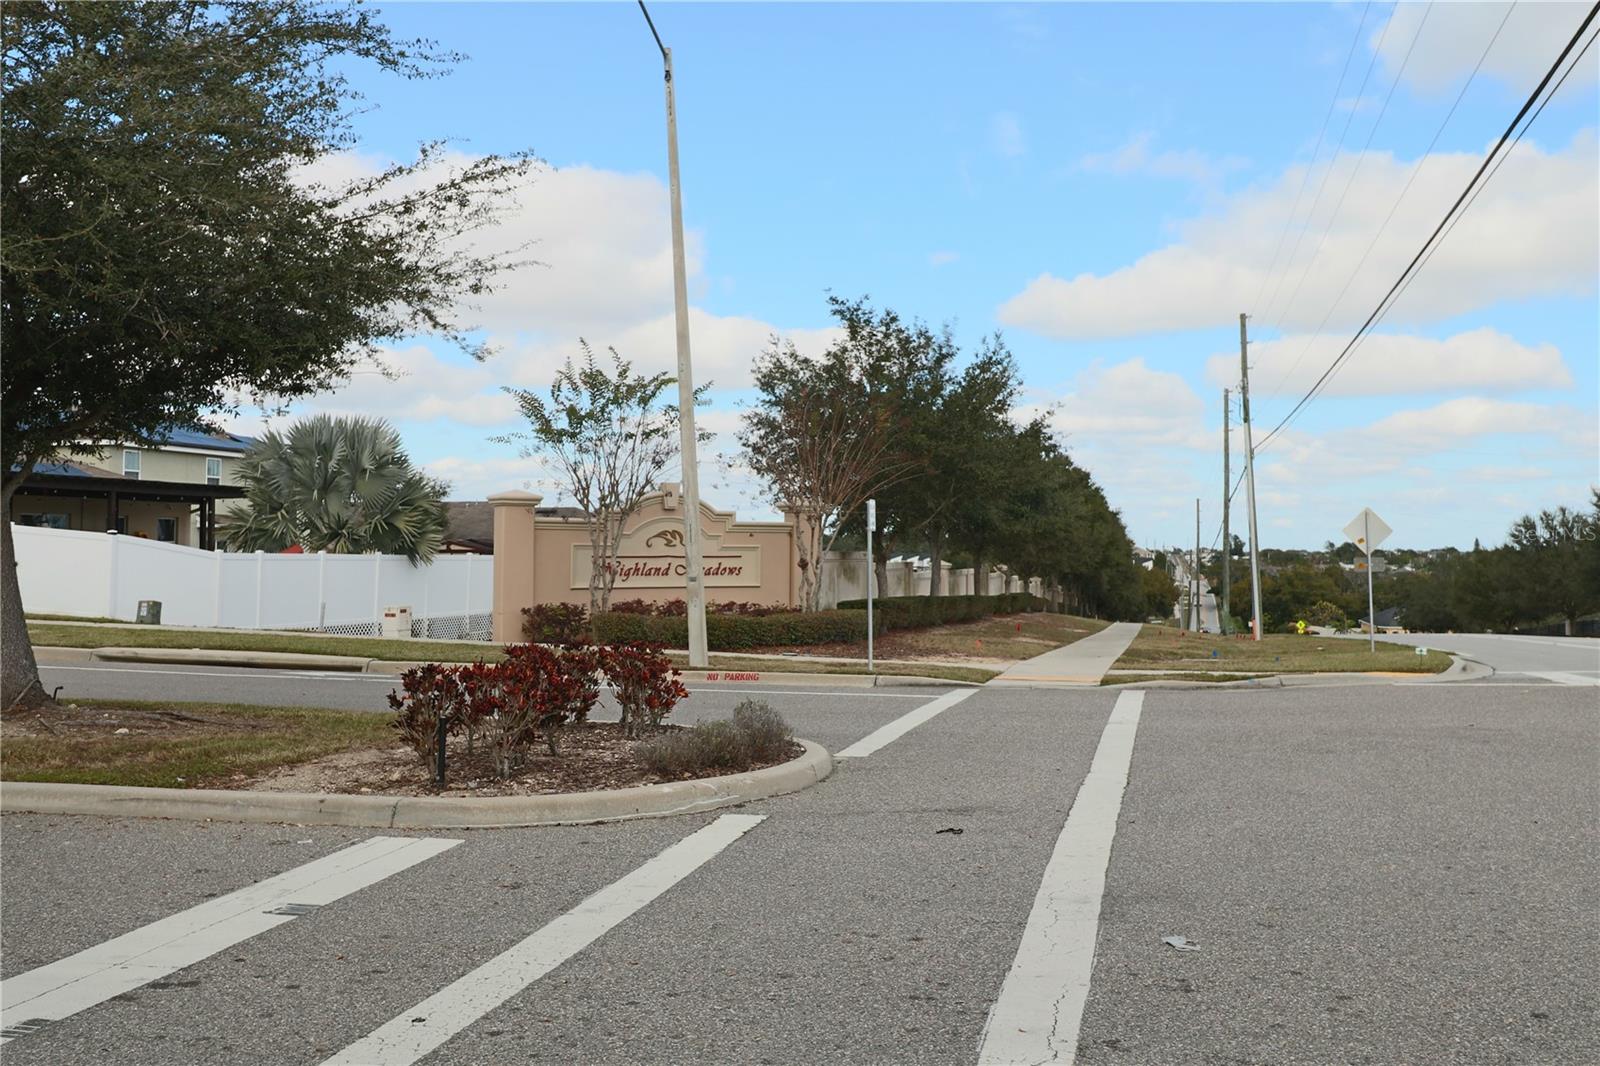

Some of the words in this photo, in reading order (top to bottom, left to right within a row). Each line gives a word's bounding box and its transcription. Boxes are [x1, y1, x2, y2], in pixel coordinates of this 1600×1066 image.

[675, 562, 743, 577] adows
[706, 672, 720, 681] NO
[724, 672, 760, 681] PARKING
